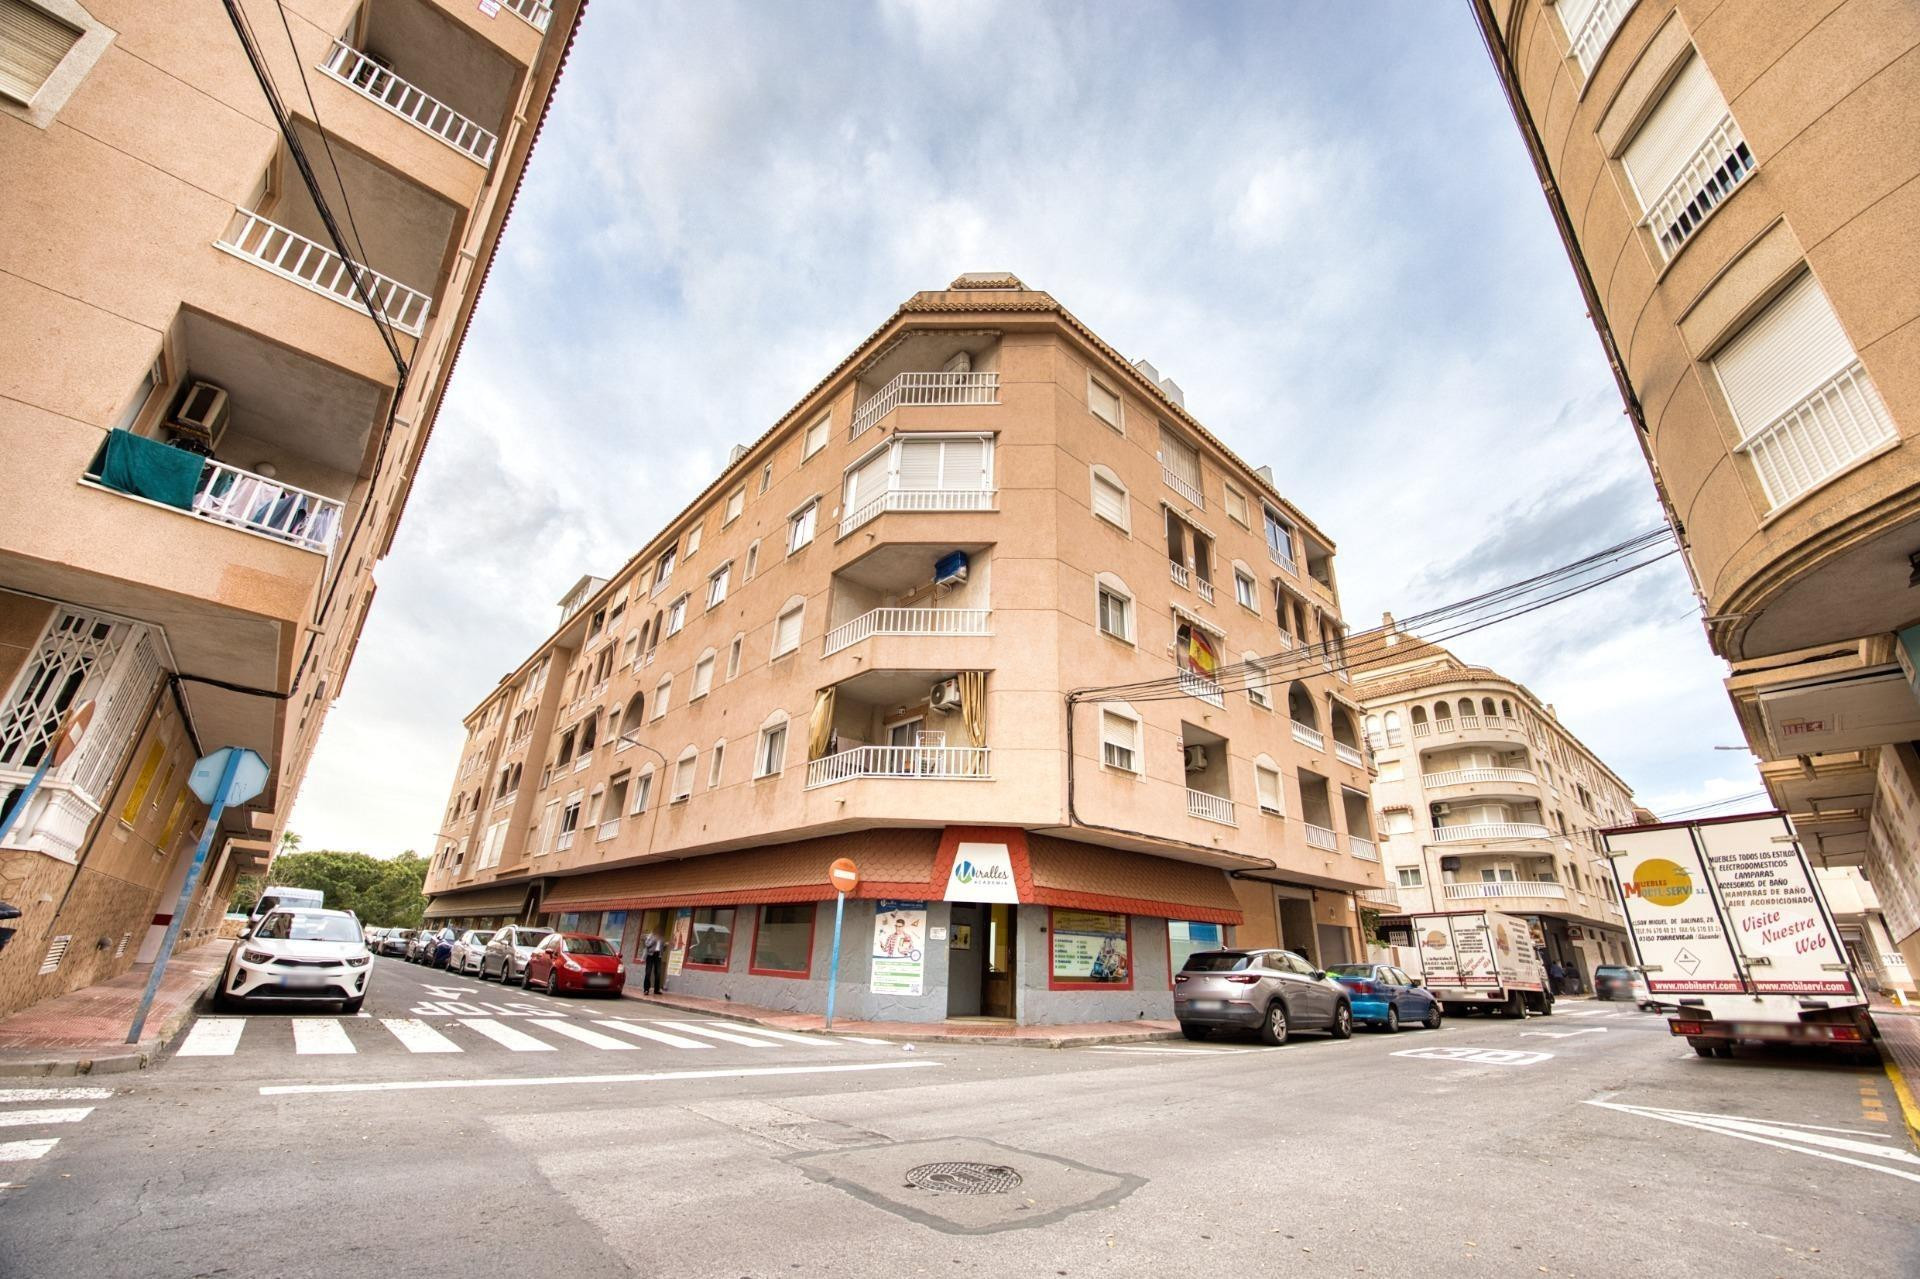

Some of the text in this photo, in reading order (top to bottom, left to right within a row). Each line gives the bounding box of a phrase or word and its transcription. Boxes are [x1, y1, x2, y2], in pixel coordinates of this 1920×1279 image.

[1709, 854, 1737, 863] MUEBLES
[1739, 853, 1758, 861] TODOS
[1772, 850, 1796, 858] ESTILOS
[955, 860, 1009, 884] Miralles
[1734, 871, 1774, 879] LAMPARAS
[1719, 880, 1755, 889] ACCESORIOS
[1725, 889, 1767, 898] MAMPARAS
[1784, 886, 1806, 895] BAÑO
[1750, 897, 1814, 906] ACONDICIONADO
[1742, 911, 1780, 933] Visite
[1762, 917, 1816, 945] Nuestra
[1795, 933, 1826, 954] Web
[1655, 980, 1737, 991] www.mobilservi.com
[1757, 981, 1845, 991] www.mobilservi.com
[409, 1001, 569, 1017] STOP
